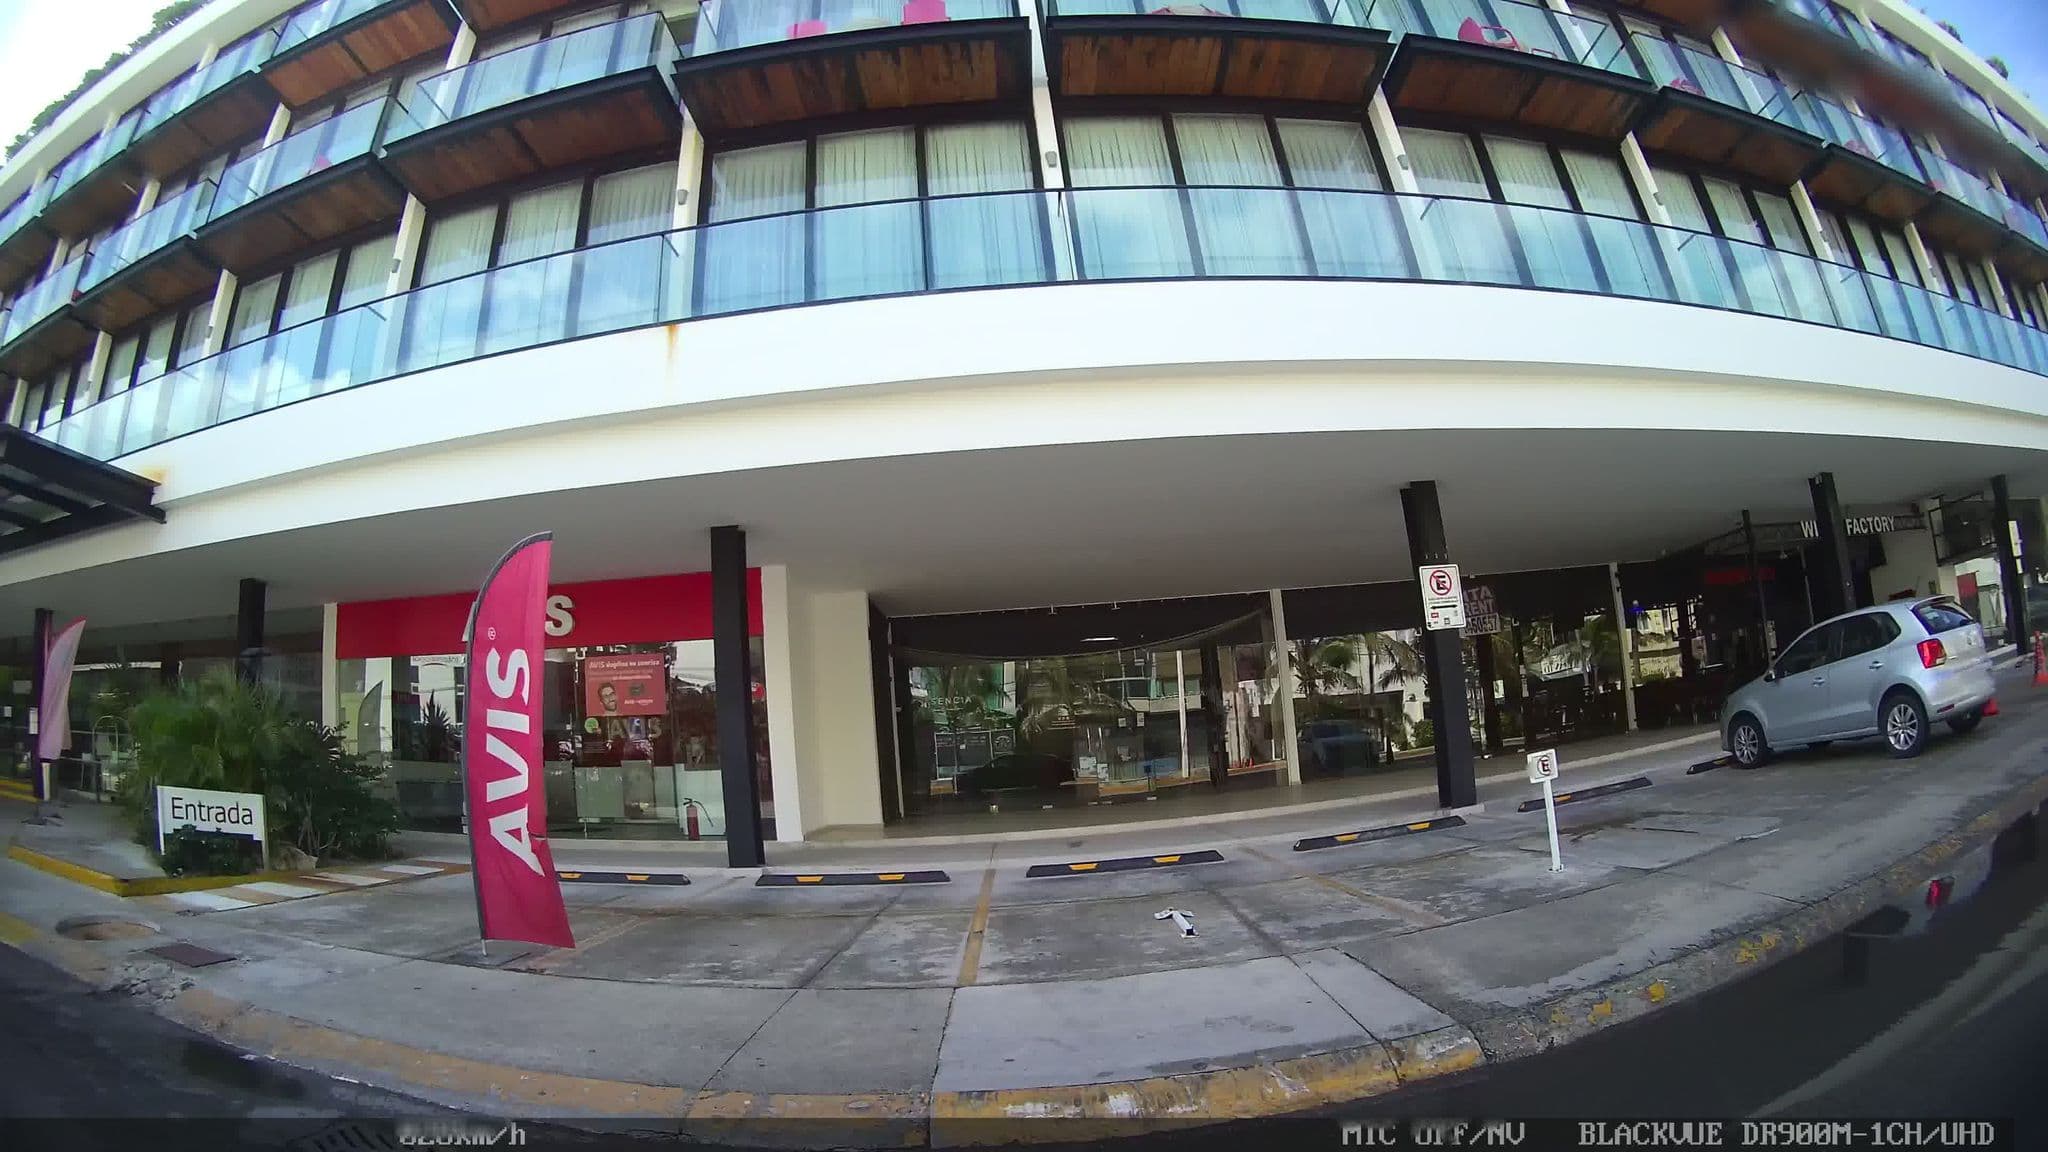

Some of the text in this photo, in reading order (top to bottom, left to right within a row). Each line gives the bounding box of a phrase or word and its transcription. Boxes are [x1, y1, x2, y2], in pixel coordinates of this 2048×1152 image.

[1845, 516, 1896, 536] FACTORY
[485, 647, 546, 877] AVIS
[171, 797, 253, 825] Entrada
